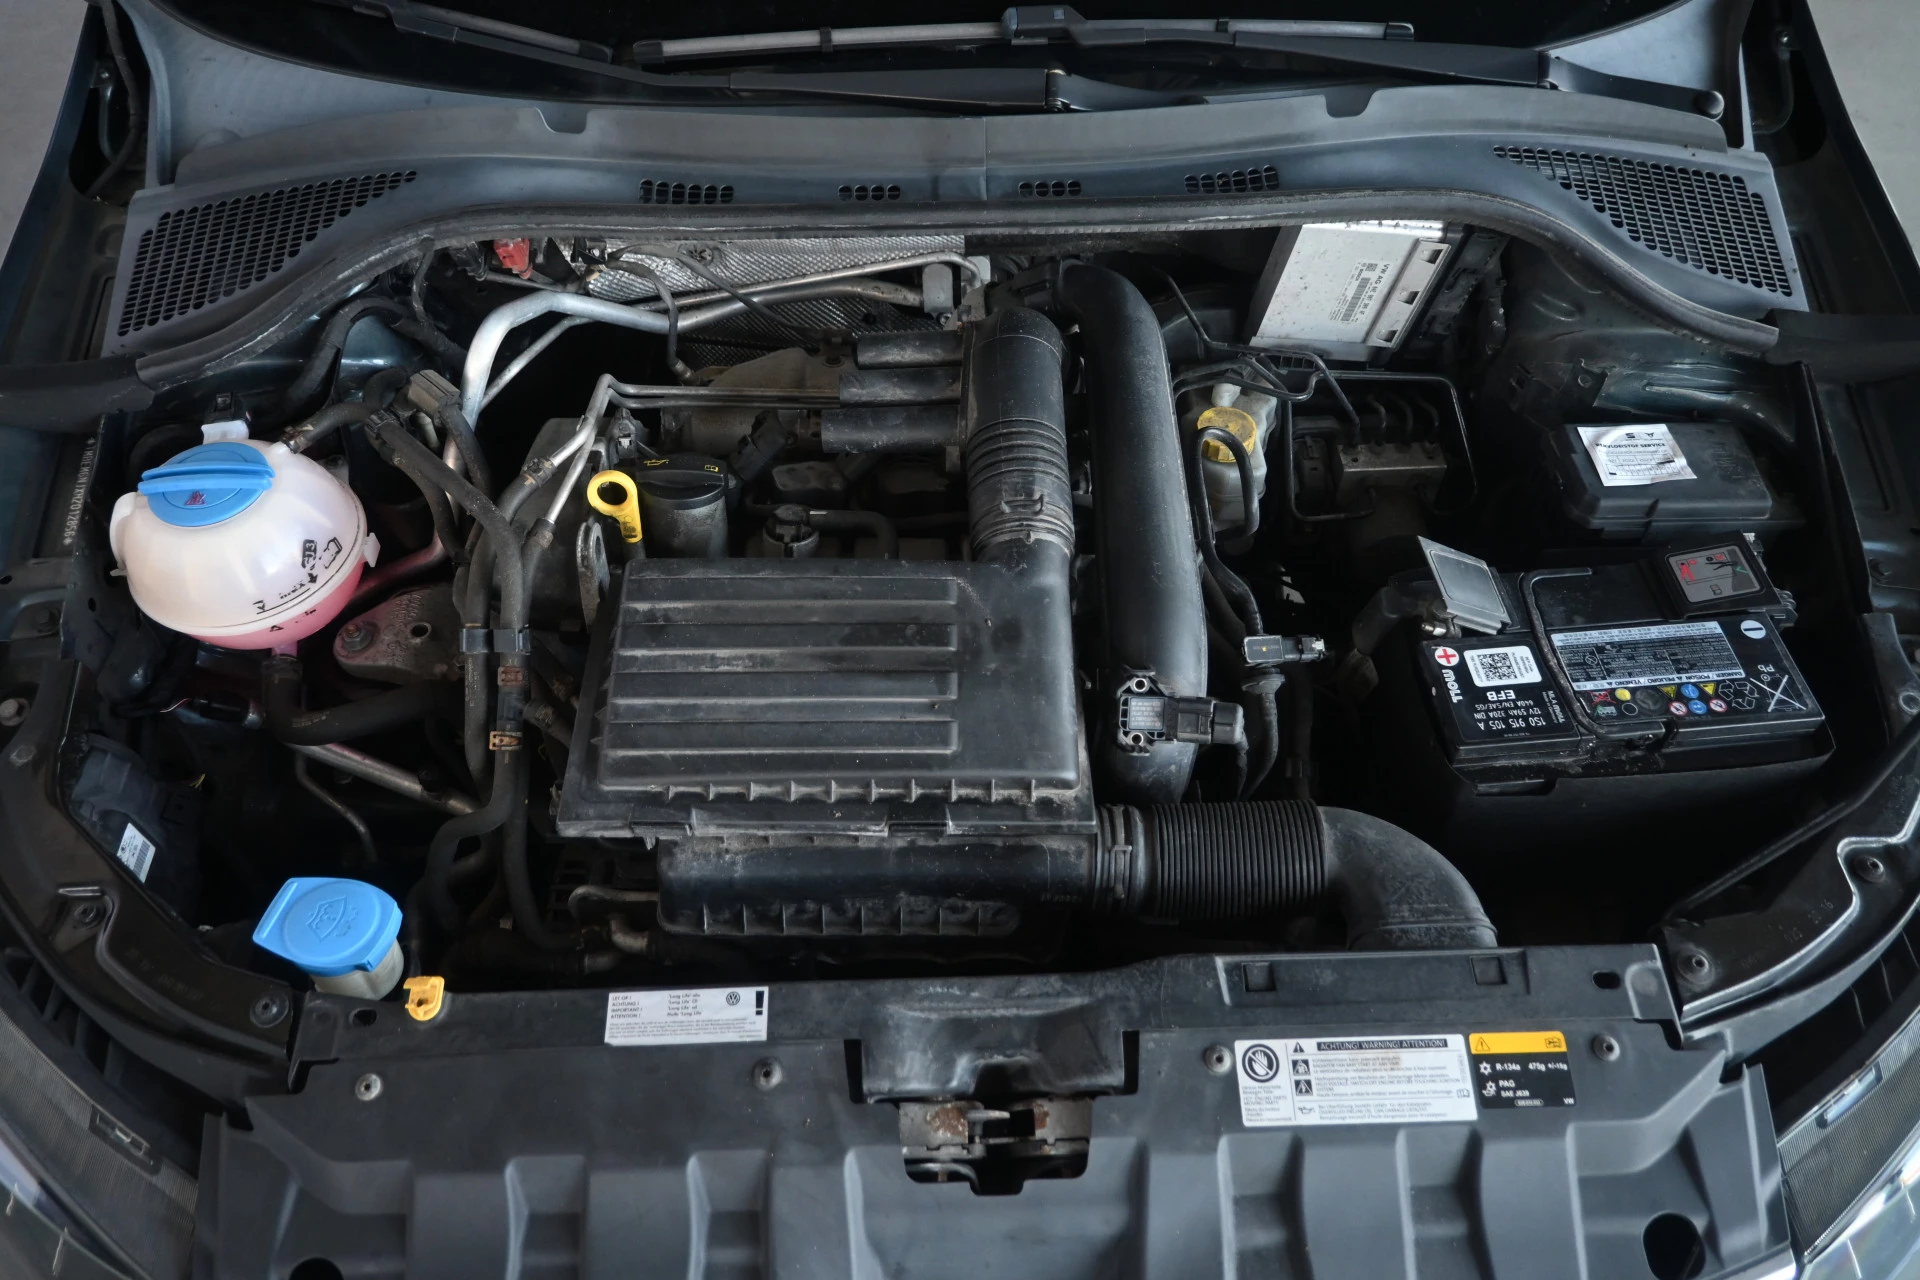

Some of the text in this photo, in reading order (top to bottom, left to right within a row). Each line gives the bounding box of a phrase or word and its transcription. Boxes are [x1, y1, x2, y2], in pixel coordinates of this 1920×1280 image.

[1757, 664, 1775, 673] Pb
[1685, 673, 1711, 681] POISON
[1715, 671, 1743, 679] DANGER
[1486, 689, 1516, 701] EFB
[1474, 707, 1542, 720] 12V 59Ah 320A DIN
[1476, 721, 1485, 731] A
[1489, 719, 1506, 730] 105
[1508, 717, 1526, 729] 915
[1319, 1039, 1446, 1051] ACHTUNG! WARNING! ATTENTION!
[1495, 1062, 1521, 1071] R-134a
[1499, 1079, 1515, 1088] PAG
[1500, 1089, 1515, 1098] SAE
[1563, 1097, 1575, 1105] VW
